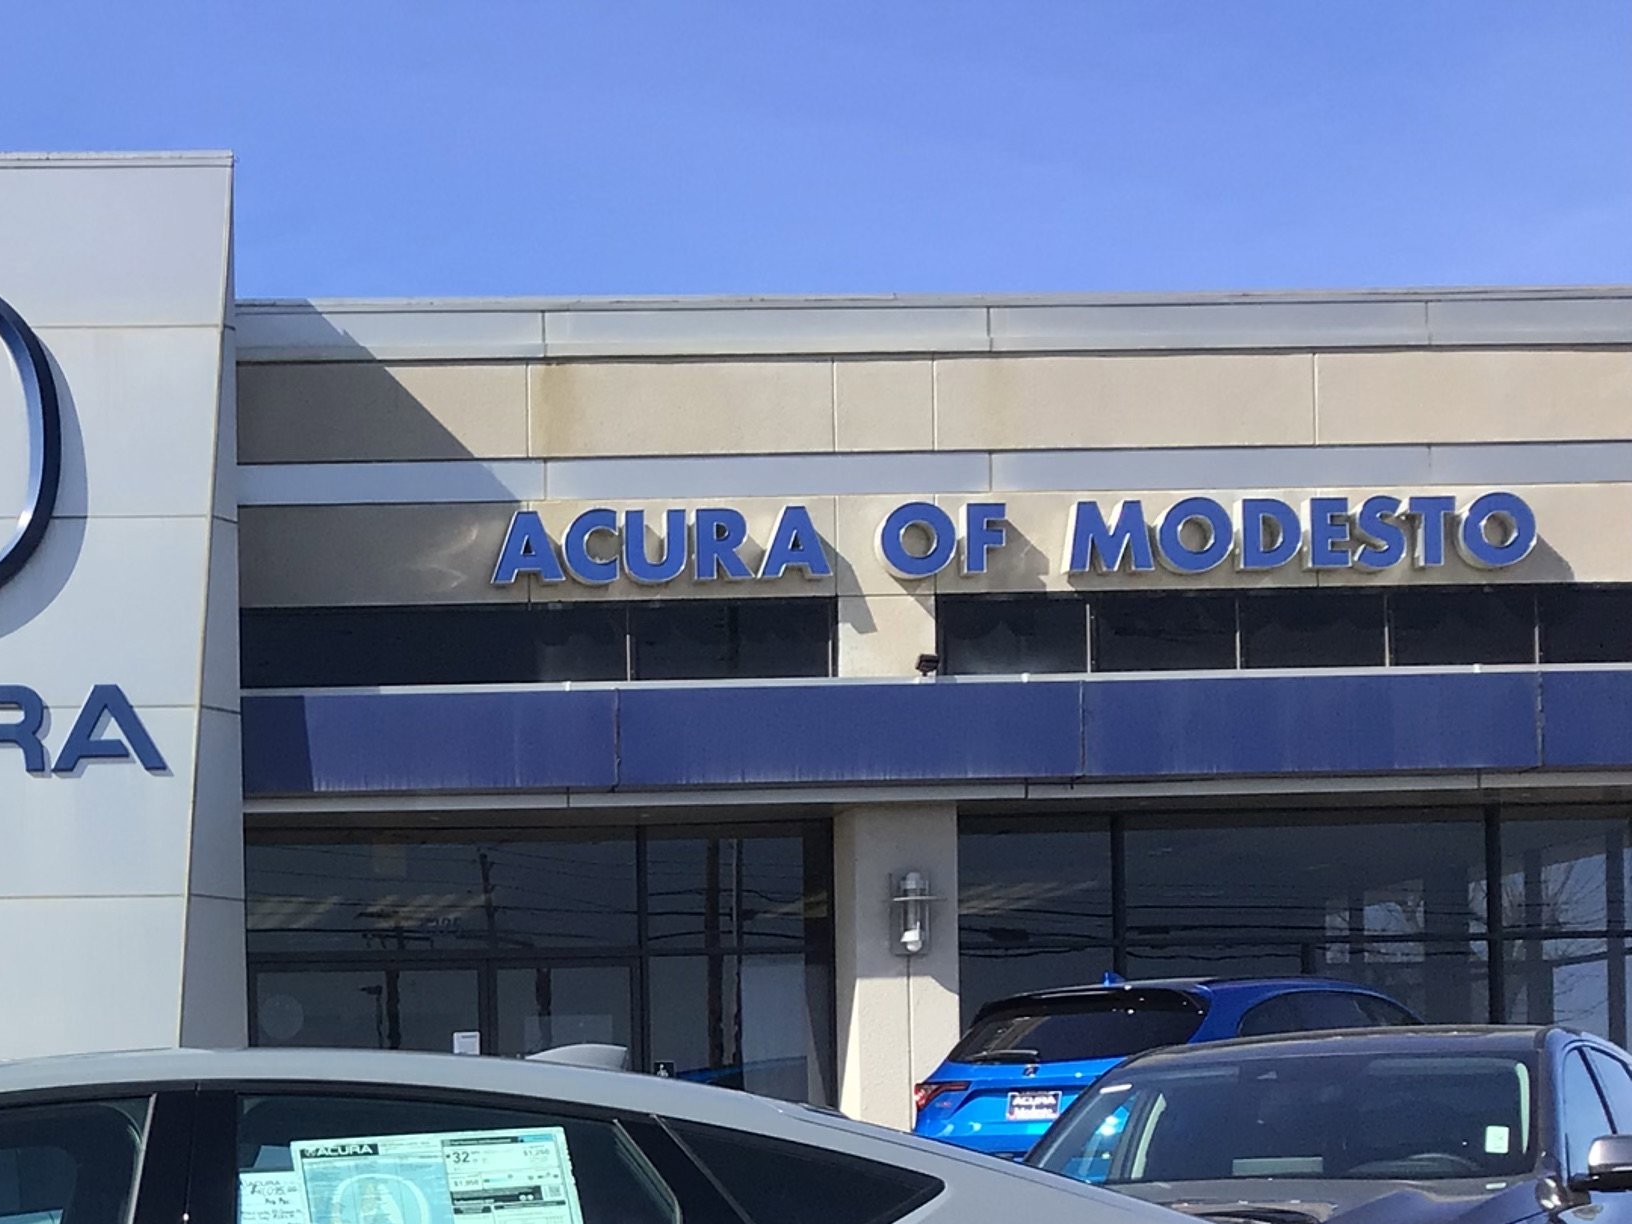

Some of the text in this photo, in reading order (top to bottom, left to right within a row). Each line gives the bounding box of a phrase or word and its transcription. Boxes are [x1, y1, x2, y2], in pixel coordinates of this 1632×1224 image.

[490, 491, 1538, 585] ACURA OF MODESTO
[316, 1143, 374, 1157] ACURA
[452, 1151, 471, 1164] 32
